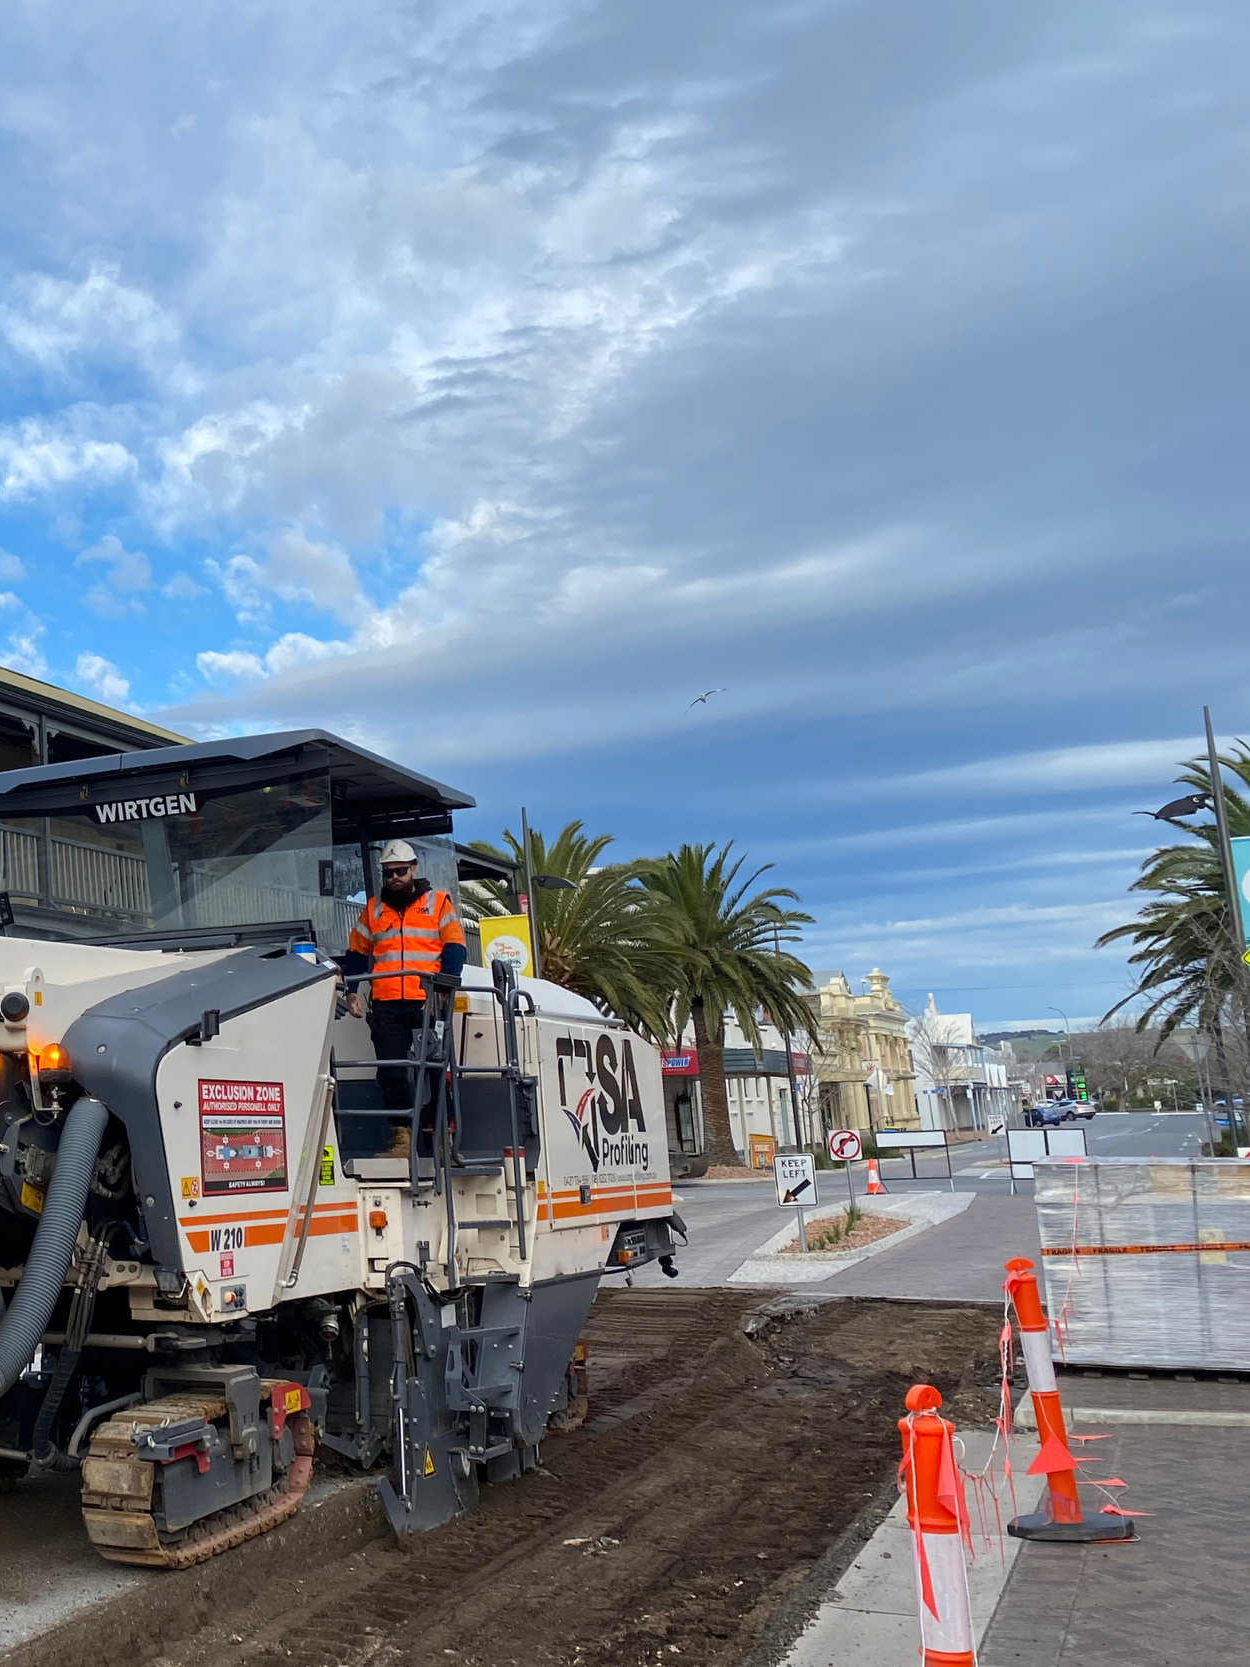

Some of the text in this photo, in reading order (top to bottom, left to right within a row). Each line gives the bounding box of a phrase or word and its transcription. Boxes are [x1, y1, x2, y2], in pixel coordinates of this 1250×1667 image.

[95, 793, 197, 823] WIRTGEN
[202, 1084, 281, 1101] EXCLUSION ZONE
[203, 1101, 237, 1111] AUTHORISED
[267, 1103, 281, 1112] ONLY
[602, 1134, 648, 1171] Profiling
[781, 1159, 807, 1168] KEEP
[783, 1170, 806, 1178] LEFT
[211, 1227, 243, 1252] W 210
